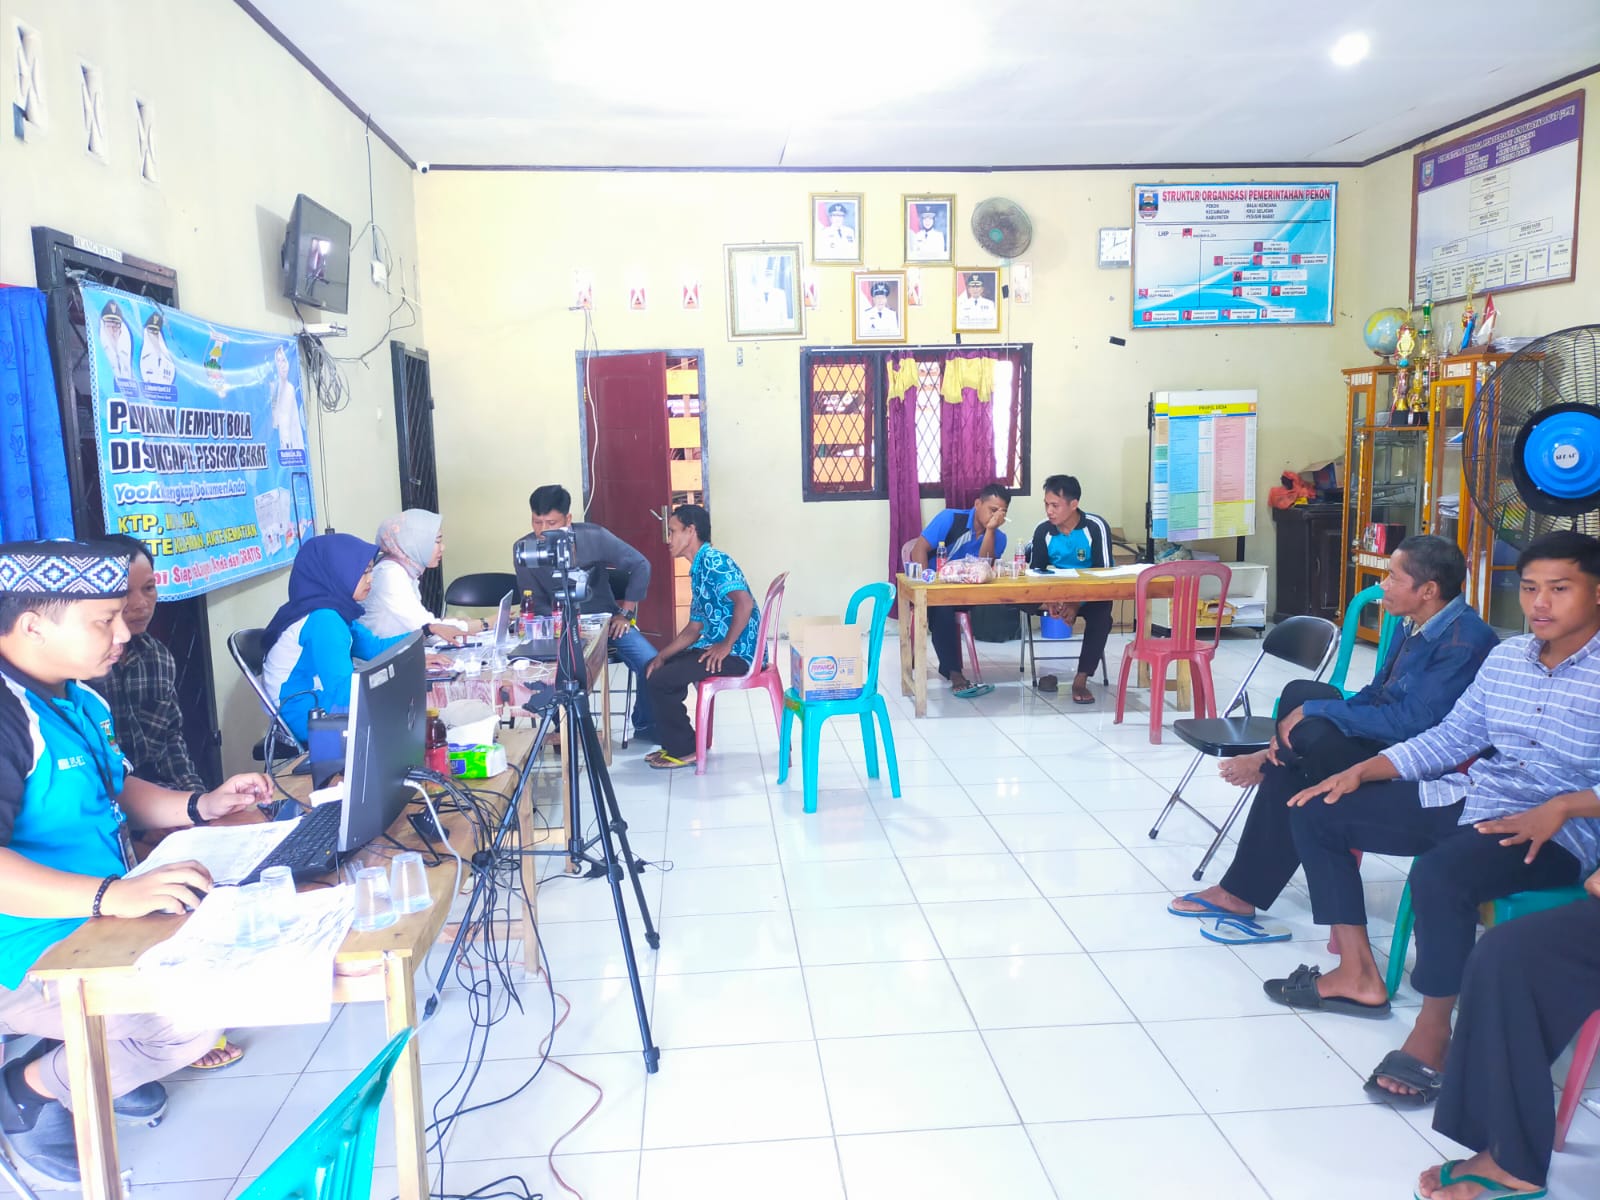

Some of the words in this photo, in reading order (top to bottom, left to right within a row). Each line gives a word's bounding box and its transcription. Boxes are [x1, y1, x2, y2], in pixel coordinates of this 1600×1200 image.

[1162, 190, 1199, 202] STRUKTUR
[1202, 189, 1247, 201] ORGANISASI
[1249, 189, 1304, 201] PEMERINTAHAN
[1305, 189, 1330, 200] PEKON
[179, 409, 225, 436] JEMPUT
[227, 413, 252, 436] BOLA
[196, 444, 239, 470] PESISIR
[240, 444, 267, 468] BARAT
[118, 513, 164, 534] KTP,
